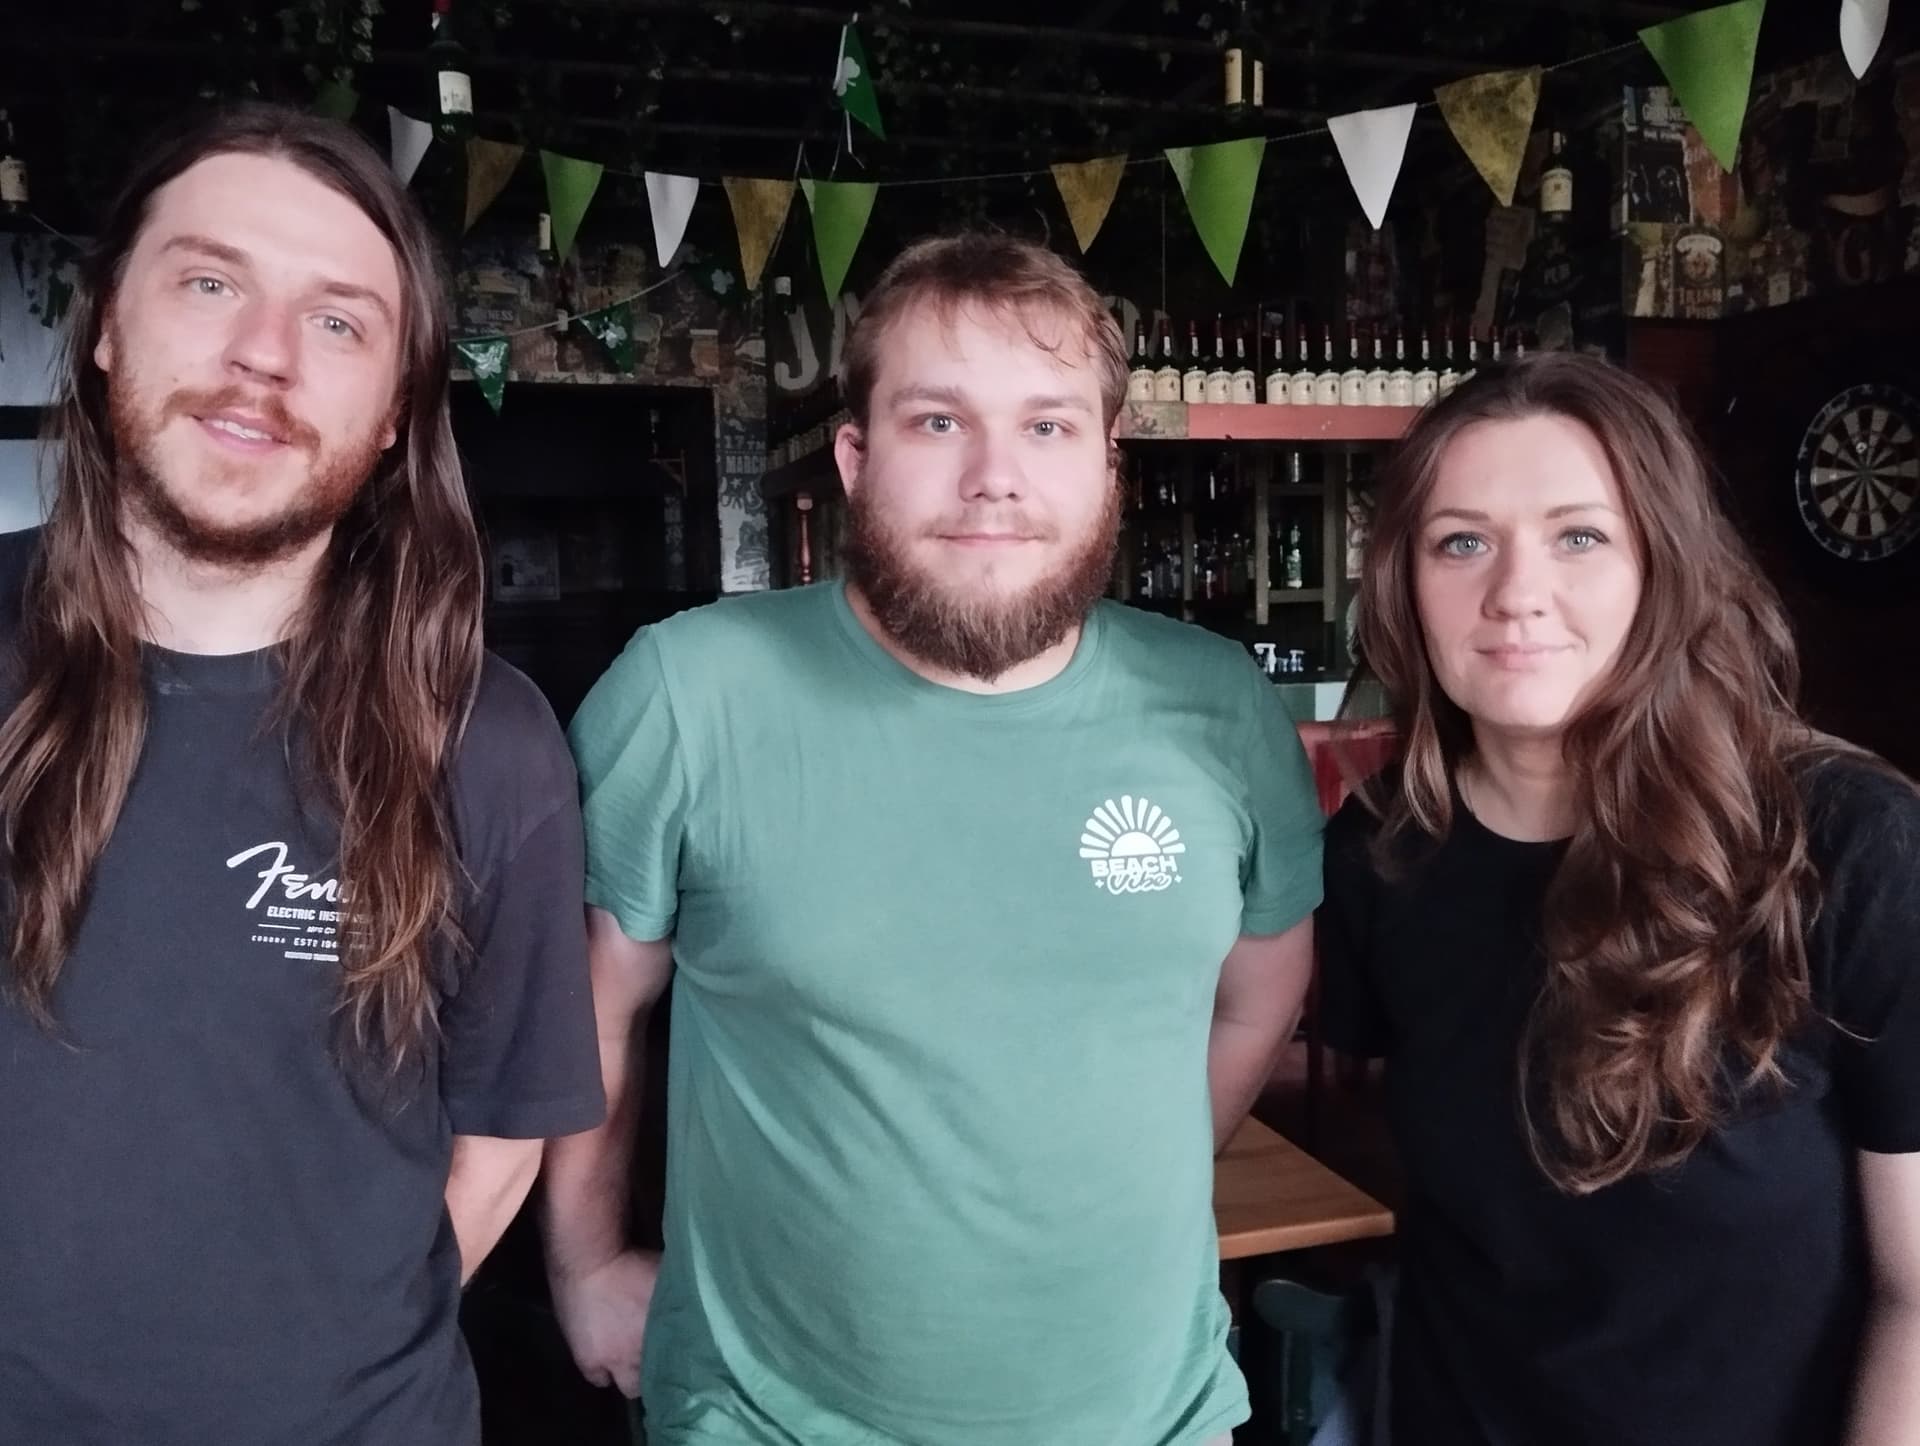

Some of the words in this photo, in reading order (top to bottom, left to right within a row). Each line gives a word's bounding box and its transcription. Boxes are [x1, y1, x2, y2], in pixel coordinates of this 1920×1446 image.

[725, 455, 768, 475] MARCH
[1091, 855, 1178, 878] BEACH
[267, 906, 316, 921] ELECTRIC
[318, 910, 348, 923] INST
[321, 939, 338, 949] 194
